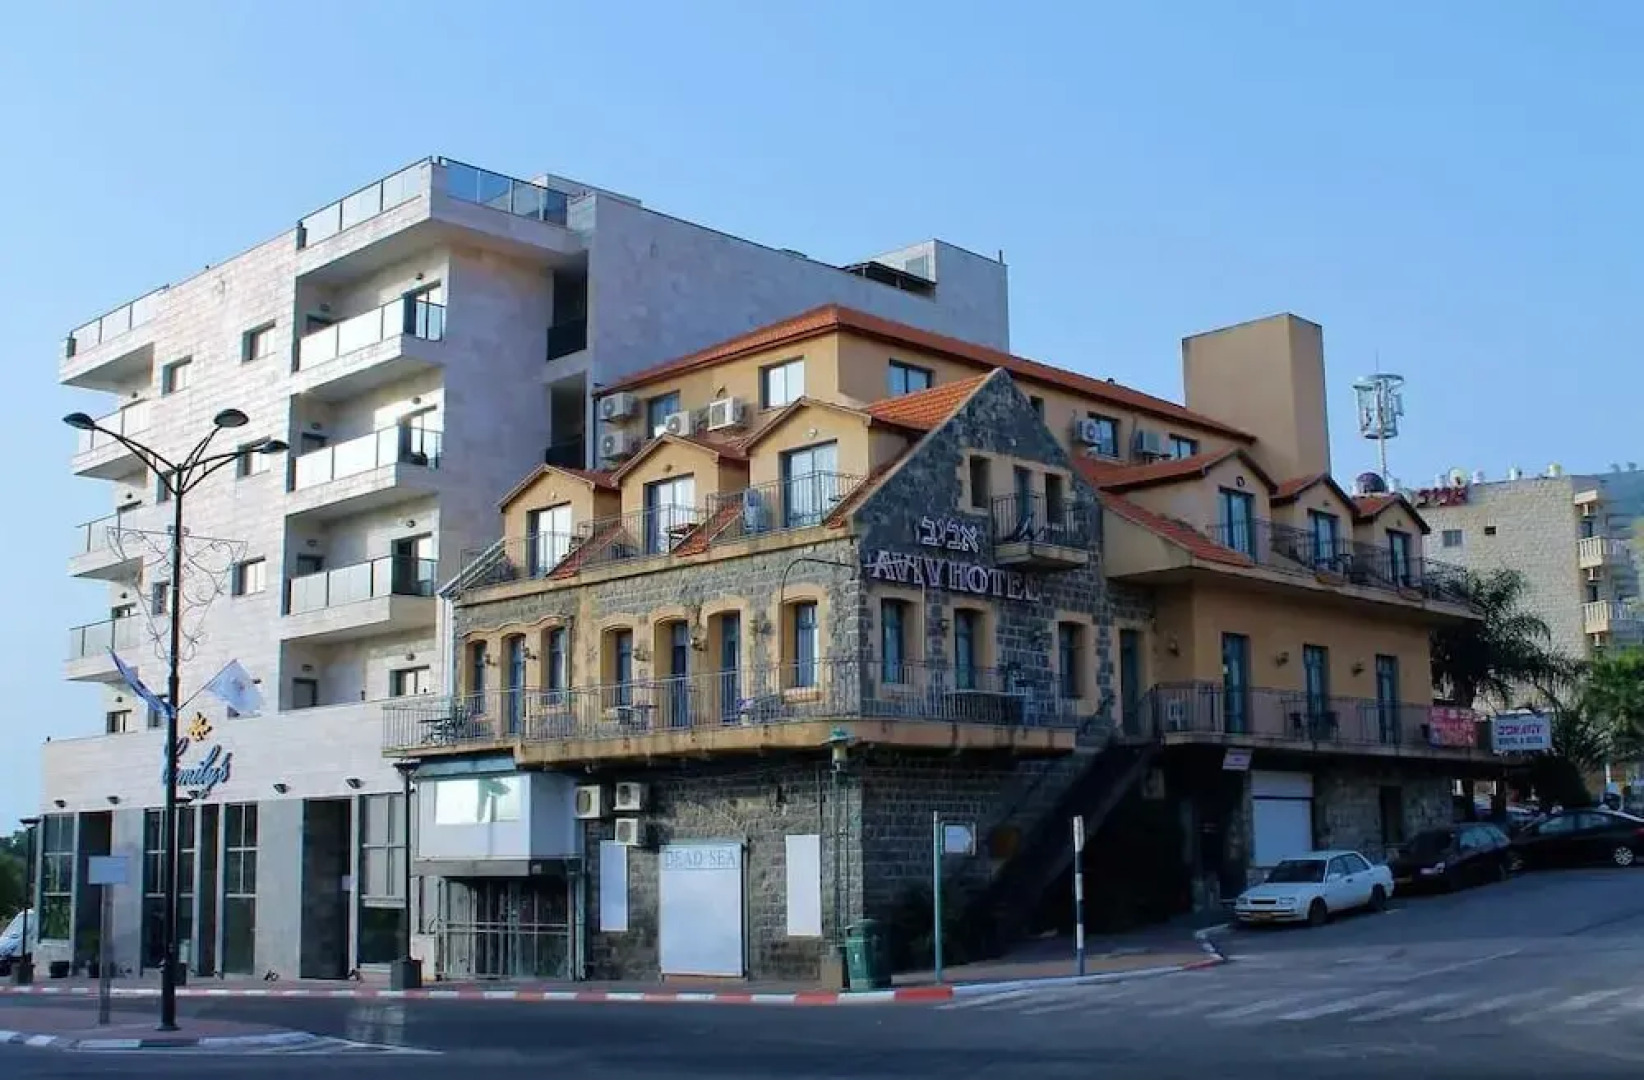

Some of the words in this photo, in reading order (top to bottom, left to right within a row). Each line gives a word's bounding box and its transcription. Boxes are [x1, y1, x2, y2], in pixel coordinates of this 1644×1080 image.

[920, 515, 979, 552] אביב
[871, 550, 944, 586] AVIV
[949, 561, 1041, 600] HOTEL
[665, 850, 703, 868] DEAD
[710, 847, 736, 868] SEA
